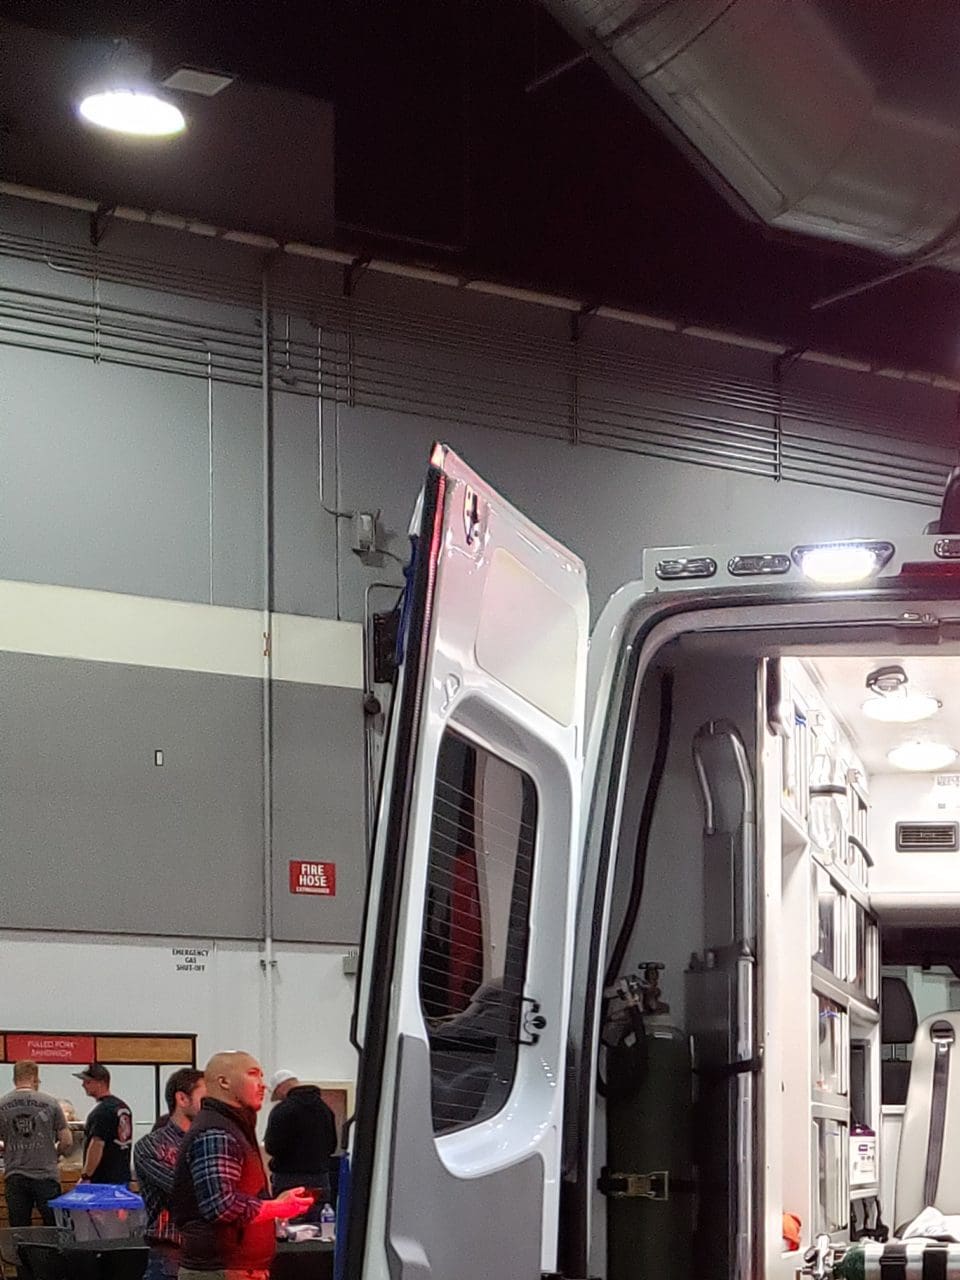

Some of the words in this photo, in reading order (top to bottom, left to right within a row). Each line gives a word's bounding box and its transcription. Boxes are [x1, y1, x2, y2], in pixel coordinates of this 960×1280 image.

[301, 863, 325, 875] FIRE
[298, 874, 328, 887] HOSE
[172, 948, 209, 957] EMERGENCY
[184, 956, 197, 964] GAS
